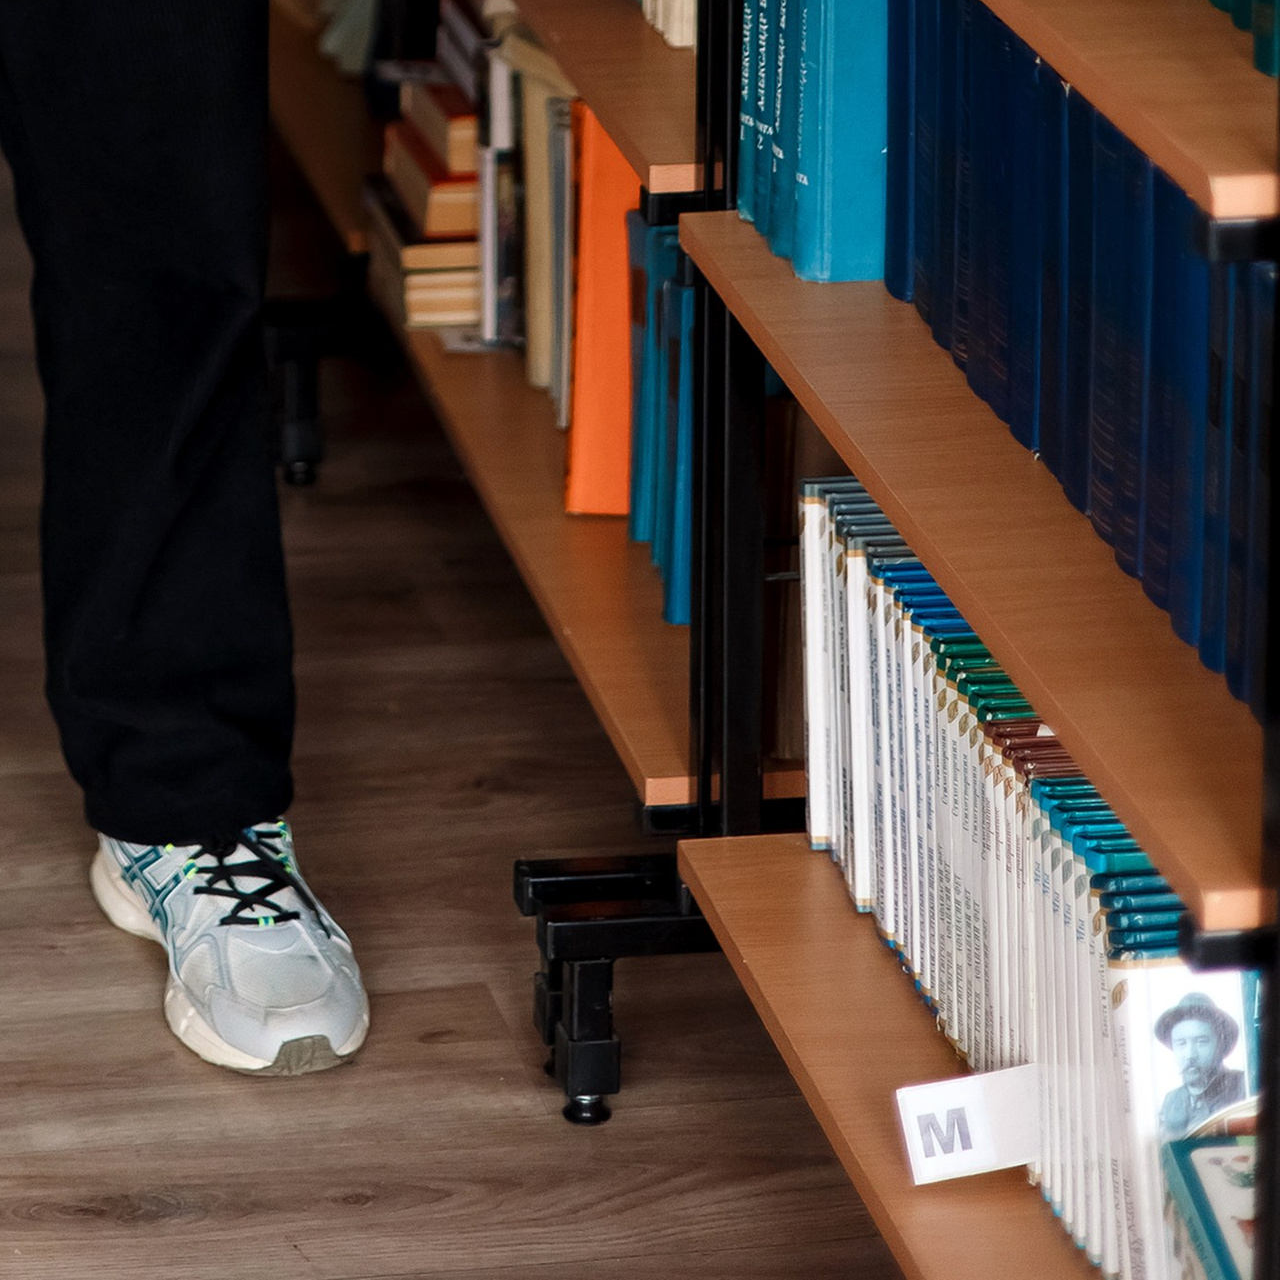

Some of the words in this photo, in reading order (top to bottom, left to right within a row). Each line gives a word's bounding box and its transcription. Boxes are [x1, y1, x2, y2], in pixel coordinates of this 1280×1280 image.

[741, 2, 753, 101] АЛЕКСАНДР
[757, 13, 770, 112] АЛЕКСАНДР
[775, 33, 787, 132] АЛЕКСАНДР
[941, 729, 950, 805] Стихотворения
[952, 740, 961, 817] Стихотворения
[962, 753, 971, 831] Стихотворения
[971, 765, 979, 844] Стихотворения
[943, 861, 951, 885] ФЕТ
[1034, 861, 1041, 885] Мы
[1042, 872, 1050, 896] Мы
[1052, 891, 1060, 915] Мы
[1063, 903, 1071, 927] Мы
[973, 926, 981, 980] АФАНАСИЙ
[1075, 919, 1085, 943] Мы
[918, 1106, 974, 1159] М
